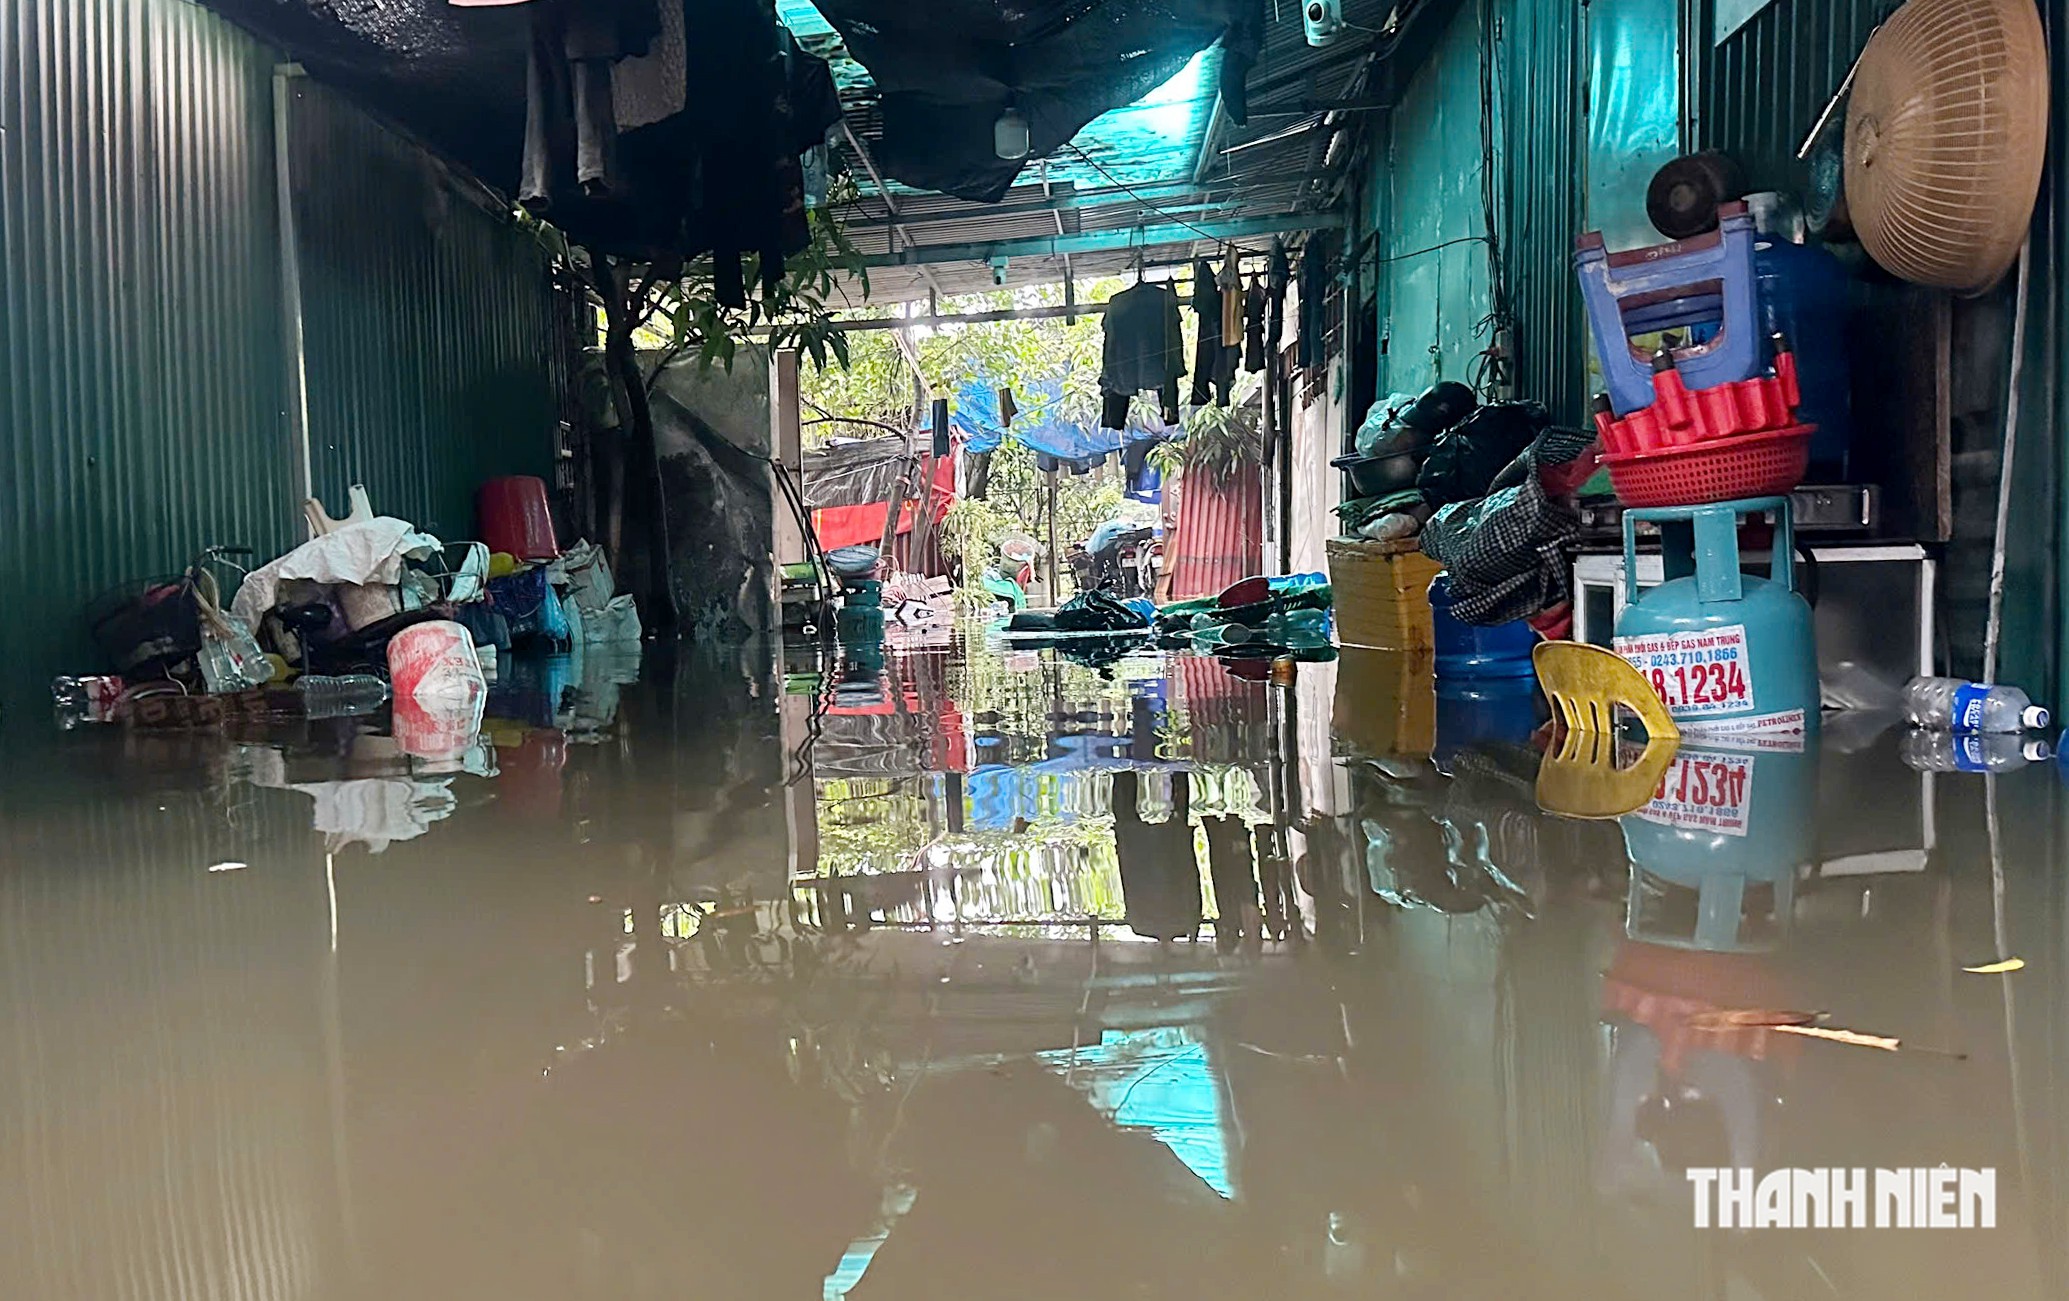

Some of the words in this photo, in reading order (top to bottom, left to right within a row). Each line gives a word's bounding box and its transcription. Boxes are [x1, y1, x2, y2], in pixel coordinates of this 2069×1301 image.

[1647, 642, 1659, 653] GAS
[1681, 639, 1696, 650] GAS
[1697, 637, 1715, 648] NAM
[1716, 633, 1741, 646] TRUNG
[1651, 647, 1738, 667] 0243.710.1866
